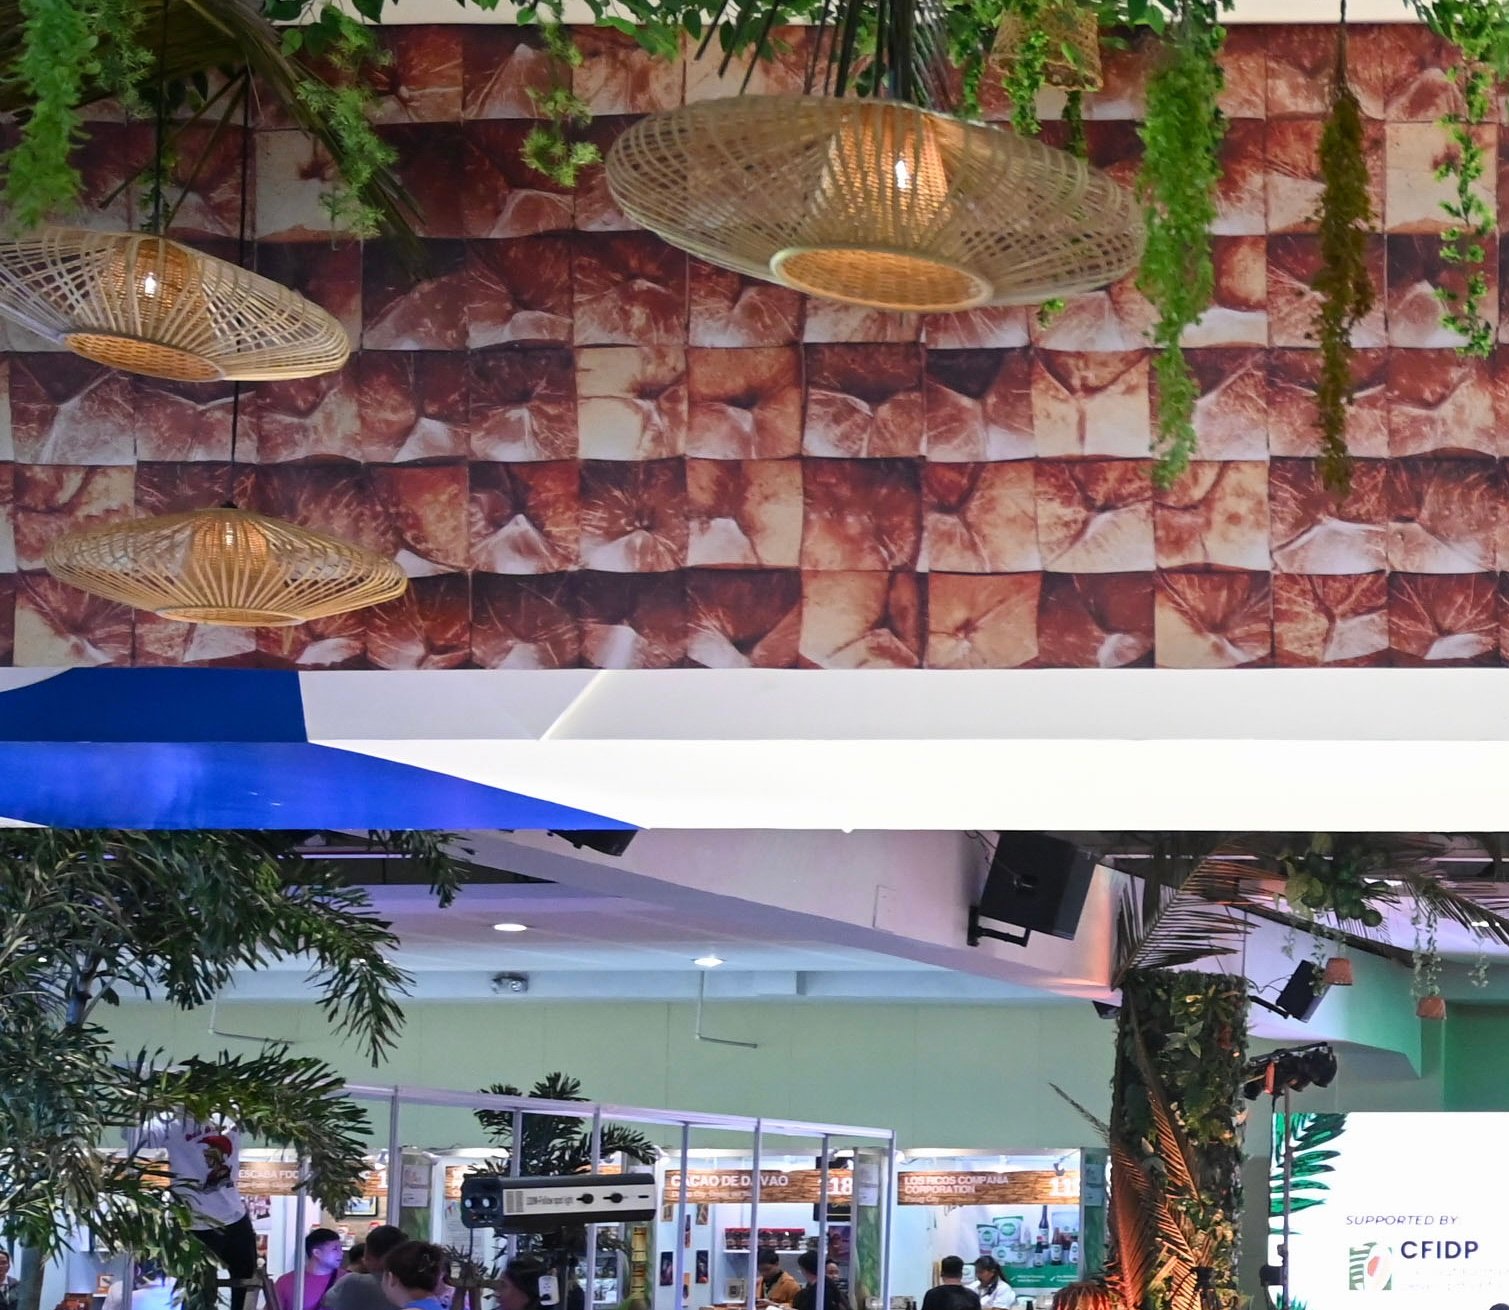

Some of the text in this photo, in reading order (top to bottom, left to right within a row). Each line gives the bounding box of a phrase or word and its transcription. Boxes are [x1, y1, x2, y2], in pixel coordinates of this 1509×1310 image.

[741, 1175, 788, 1187] DVAO
[904, 1185, 976, 1193] CORPORATION
[1346, 1215, 1434, 1225] SUPPORTED
[1400, 1240, 1479, 1259] CFIDP
